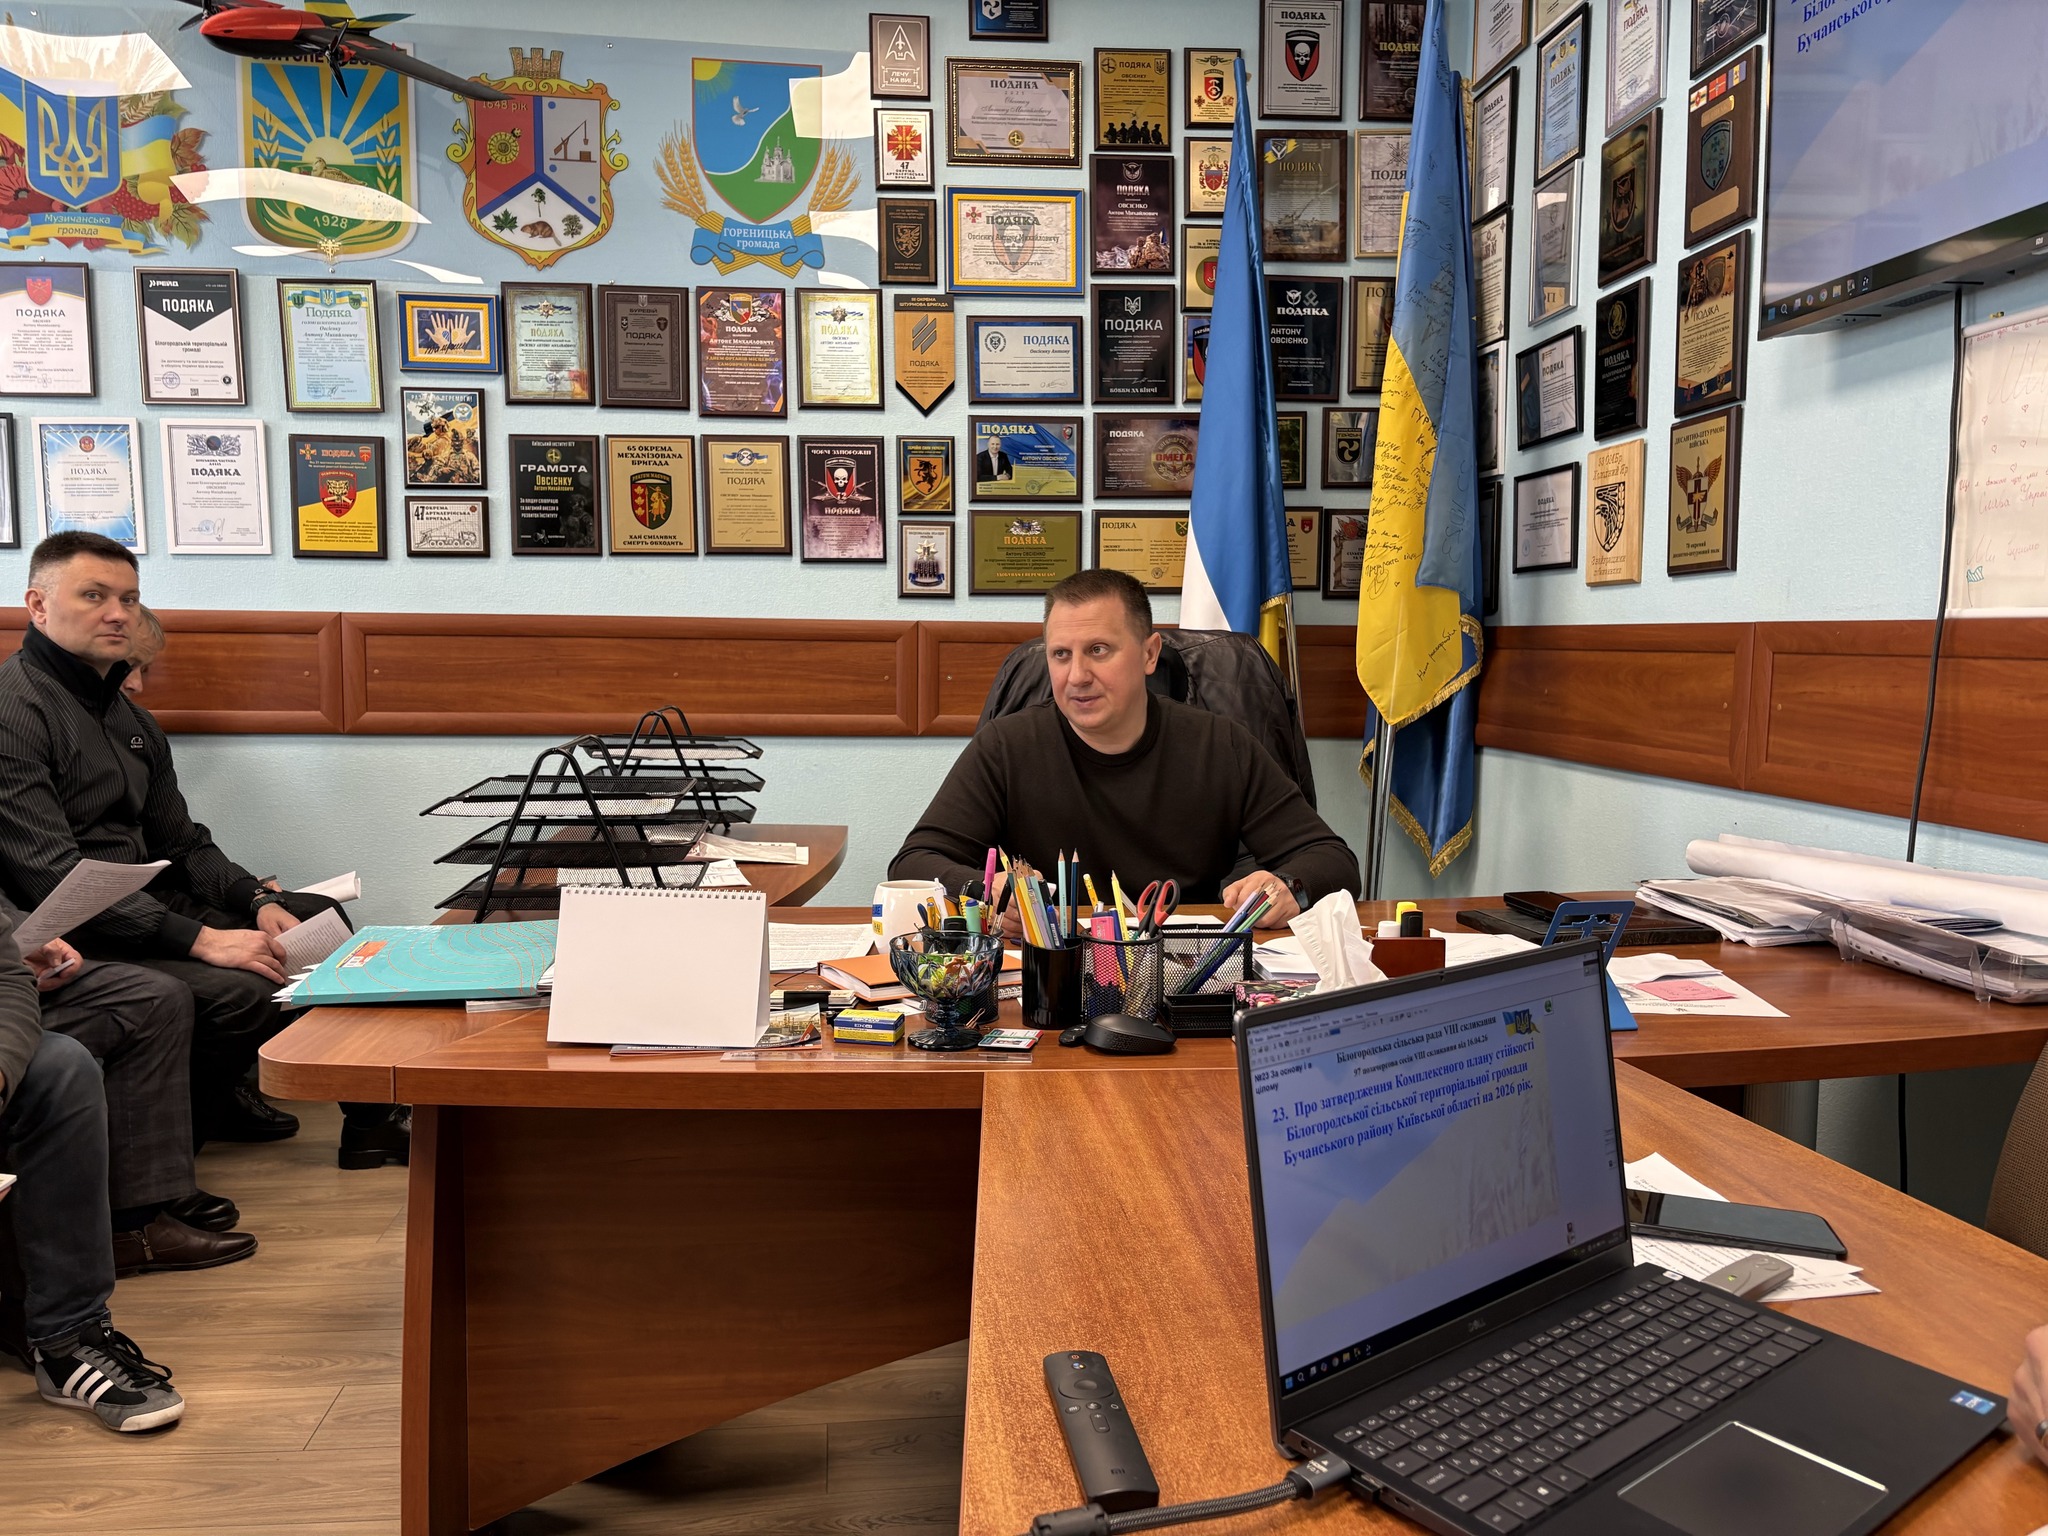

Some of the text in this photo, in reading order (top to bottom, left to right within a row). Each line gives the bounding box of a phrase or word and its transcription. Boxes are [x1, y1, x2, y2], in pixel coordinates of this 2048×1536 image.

[1280, 11, 1327, 21] ПОДЯКА
[1623, 4, 1649, 32] ПОДЯКА
[1379, 41, 1421, 52] ПОДЯК
[1119, 61, 1152, 69] ПОДЯКА
[1550, 62, 1576, 89] ПОДЯКА
[990, 78, 1039, 90] ПОДЯКА
[900, 161, 910, 170] 47
[1279, 161, 1323, 173] ПОДЯКА
[1370, 170, 1407, 182] ПОДЯ
[44, 212, 112, 226] Музичанська
[312, 214, 349, 230] 1928
[985, 215, 1041, 226] ПОДЯКА
[56, 225, 99, 238] громада
[723, 227, 794, 240] ГОРЕНИЦЬКА
[736, 239, 781, 250] громада
[1366, 286, 1395, 298] ПОД
[162, 298, 215, 314] ПОДЯКА
[15, 308, 67, 319] ПОДЯКА
[305, 306, 353, 319] Подяка
[1276, 307, 1330, 317] ПОДЯКА
[1693, 304, 1720, 322] ПОДЯКА
[820, 325, 859, 336] ПОДЯКА
[1104, 319, 1163, 333] ПОДЯКА
[530, 328, 565, 338] ПОДЯКА
[625, 332, 663, 341] ПОДЯКА
[1023, 335, 1070, 346] ПОДЯКА
[1270, 337, 1309, 345] ОВСІЄНКО
[1604, 349, 1630, 368] ПОДЯКА
[1542, 360, 1564, 377] ПОДЯКА
[981, 424, 1037, 435] ПОДЯКА
[1109, 430, 1145, 438] ПОДЯКА
[1155, 453, 1193, 462] ОМЕГА
[69, 467, 108, 476] ПОДЯКА
[190, 467, 242, 478] ПОДЯКА
[520, 464, 588, 473] ГРАМОТА
[726, 476, 766, 486] ПОДЯКА
[835, 492, 847, 500] 72
[414, 505, 425, 521] 47
[824, 507, 861, 515] ПОДЯКА
[1101, 522, 1137, 530] ПОДЯКА
[1003, 536, 1047, 545] ПОДЯКА
[1336, 1016, 1497, 1064] Білогородська сільська рада VIII скликання
[1254, 1072, 1270, 1083] №23
[1270, 1070, 1279, 1079] За
[1280, 1064, 1303, 1077] основу
[1353, 1067, 1362, 1077] 97
[1272, 1039, 1535, 1124] 23. Про затвердження Комплексного плану стійкості
[1255, 1083, 1279, 1095] цілому
[1286, 1061, 1528, 1143] Білогородської сільської територіальної громади
[1283, 1077, 1534, 1166] Бучанського району Київської області на 2026 рік.
